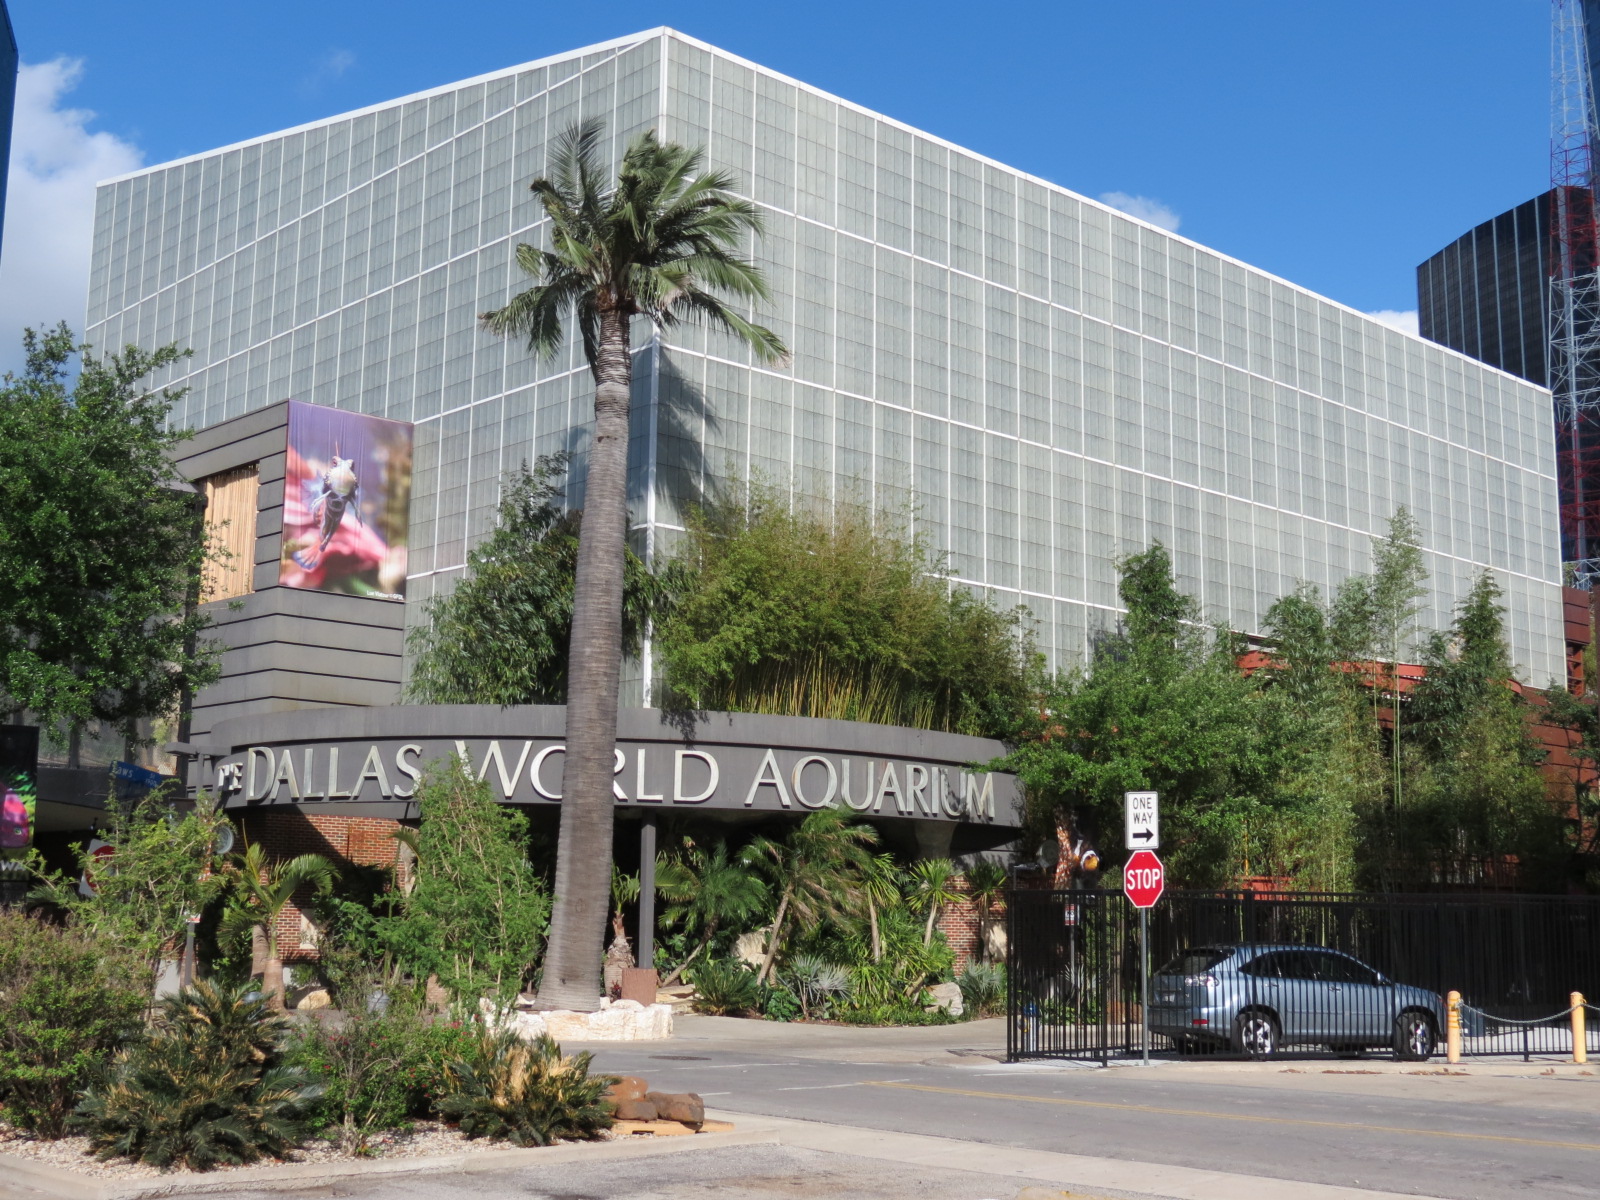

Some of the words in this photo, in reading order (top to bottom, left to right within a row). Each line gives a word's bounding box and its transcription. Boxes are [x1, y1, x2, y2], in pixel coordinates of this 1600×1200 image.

[112, 765, 134, 778] aws
[217, 762, 244, 791] THE
[246, 744, 423, 802] DALLAS
[744, 748, 996, 820] AQUARIUM
[1132, 797, 1153, 810] ONE
[1133, 813, 1154, 825] WAY
[1127, 868, 1161, 891] STOP
